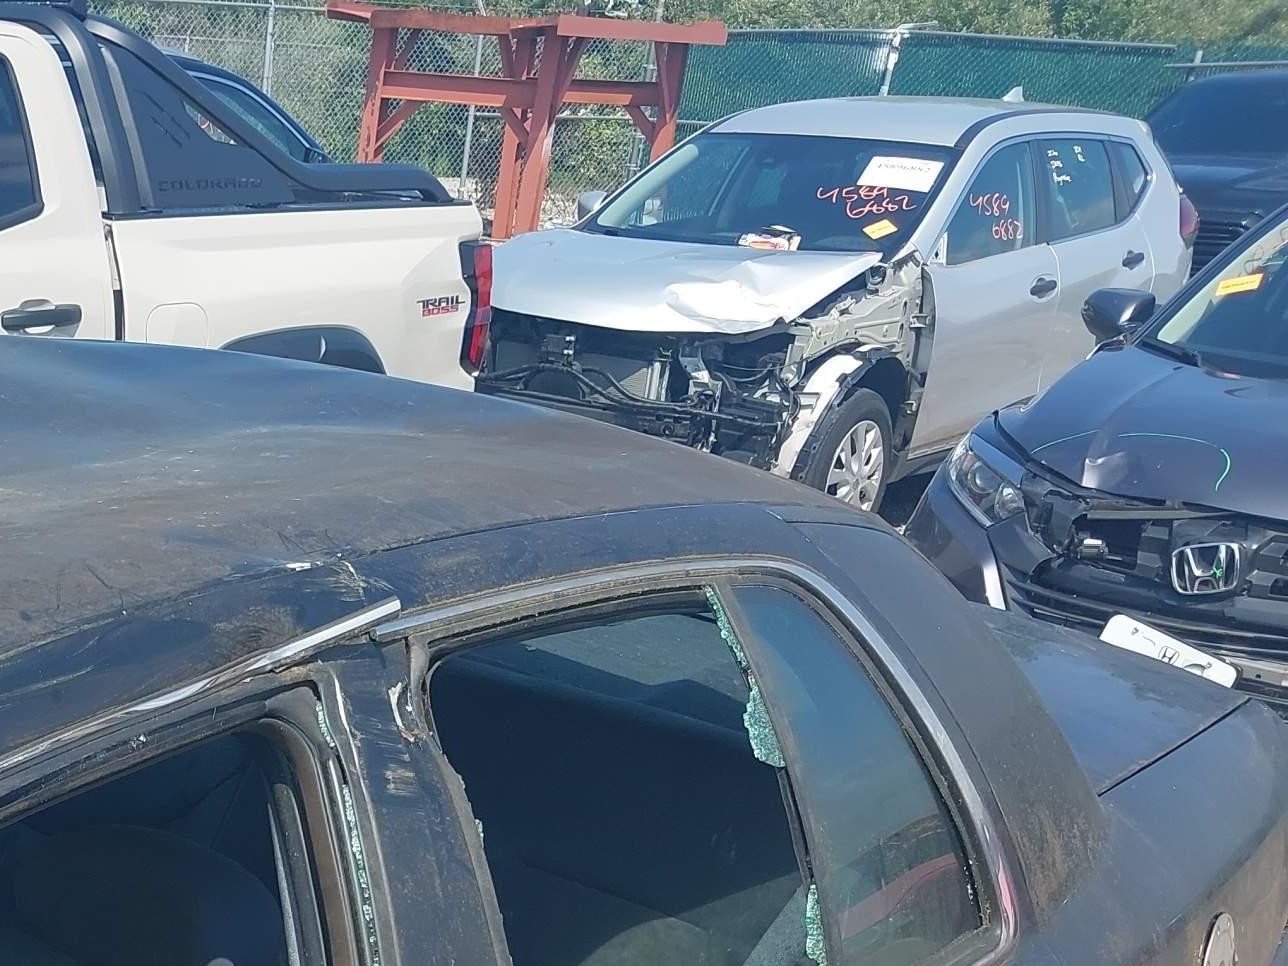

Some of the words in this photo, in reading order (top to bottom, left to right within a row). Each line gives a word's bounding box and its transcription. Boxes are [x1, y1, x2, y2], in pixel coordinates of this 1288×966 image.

[158, 178, 262, 192] COLORADO
[969, 193, 1010, 216] 4589
[416, 295, 466, 309] TRAIL
[422, 304, 459, 317] BOSS
